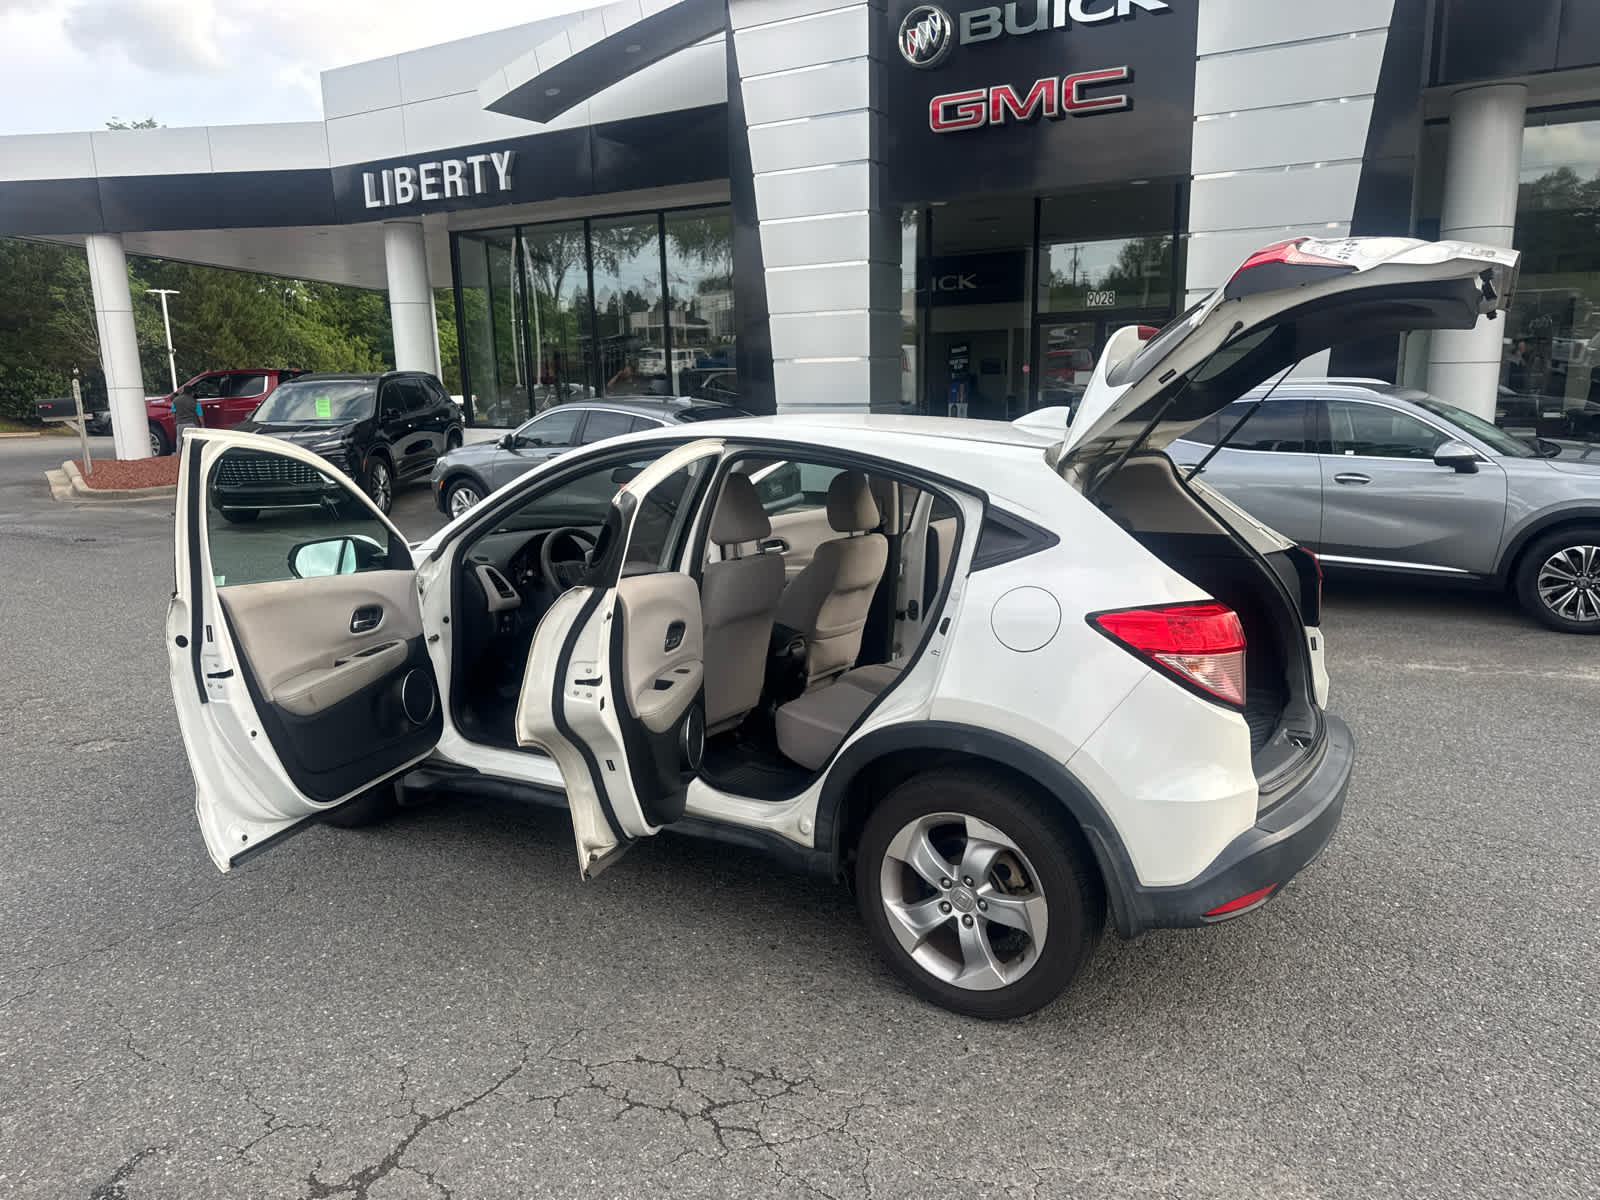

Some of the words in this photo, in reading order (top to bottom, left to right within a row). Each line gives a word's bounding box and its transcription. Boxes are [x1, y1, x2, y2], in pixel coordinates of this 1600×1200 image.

[929, 65, 1128, 133] GMC
[363, 150, 516, 208] LIBERTY
[915, 272, 977, 292] ICK
[1087, 291, 1115, 305] 9028
